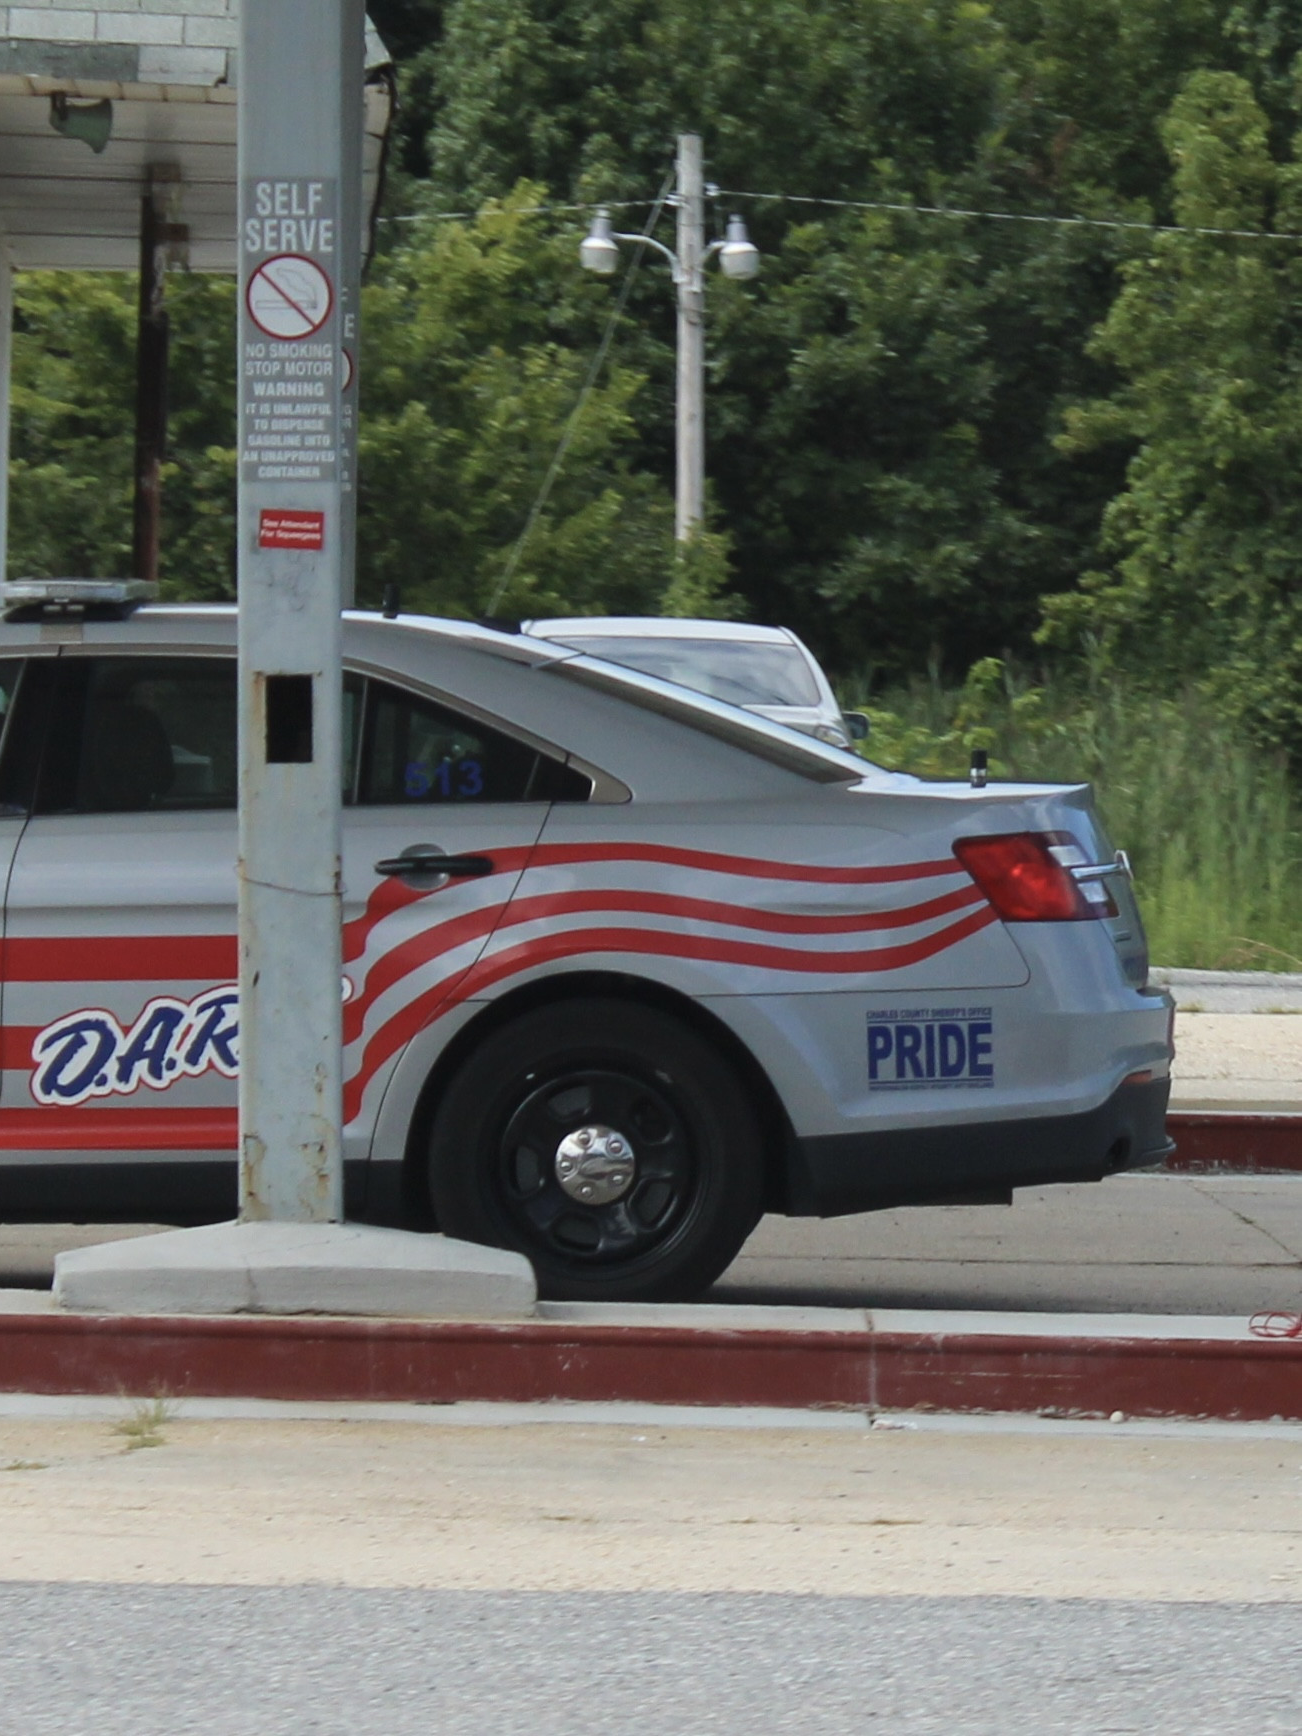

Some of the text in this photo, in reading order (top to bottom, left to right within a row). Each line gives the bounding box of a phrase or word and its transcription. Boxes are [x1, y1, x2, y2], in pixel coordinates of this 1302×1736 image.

[255, 181, 323, 217] SELF
[244, 218, 334, 253] SERVE
[244, 343, 334, 358] NO SMOKING
[244, 361, 333, 376] STOP MOTOR
[253, 382, 325, 397] WARNING
[245, 403, 257, 415] IT
[260, 403, 270, 415] IS
[272, 403, 332, 416] UNLAWFUL
[254, 419, 326, 432] TO DISPENSE
[247, 434, 331, 447] GASOLINE INTO
[242, 450, 335, 463] AN UNAPPROVED
[257, 465, 321, 479] CONTAINER
[403, 760, 485, 798] 513
[867, 1022, 994, 1079] PRIDE
